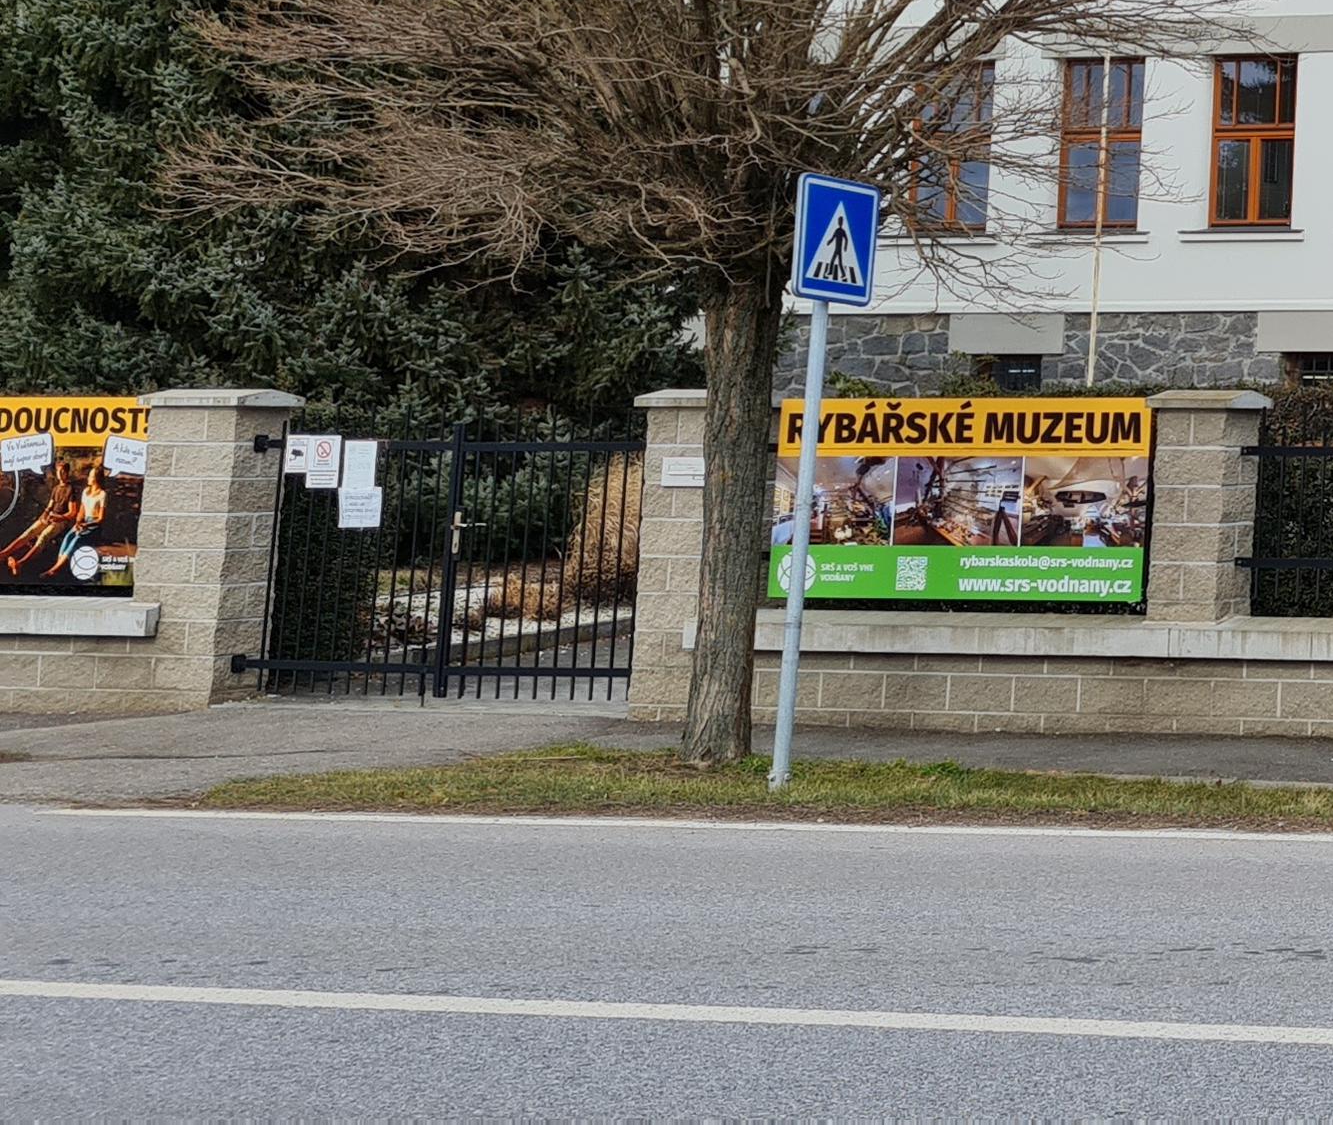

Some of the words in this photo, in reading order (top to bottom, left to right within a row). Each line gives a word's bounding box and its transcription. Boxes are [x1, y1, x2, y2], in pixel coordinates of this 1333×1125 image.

[787, 401, 975, 444] RYBÁŘSKÉ
[983, 412, 1142, 444] MUZEUM
[960, 555, 1133, 570] rybarskaskola@srs-vodnany.cz
[958, 575, 1132, 596] www.srs-vodnany.cz
